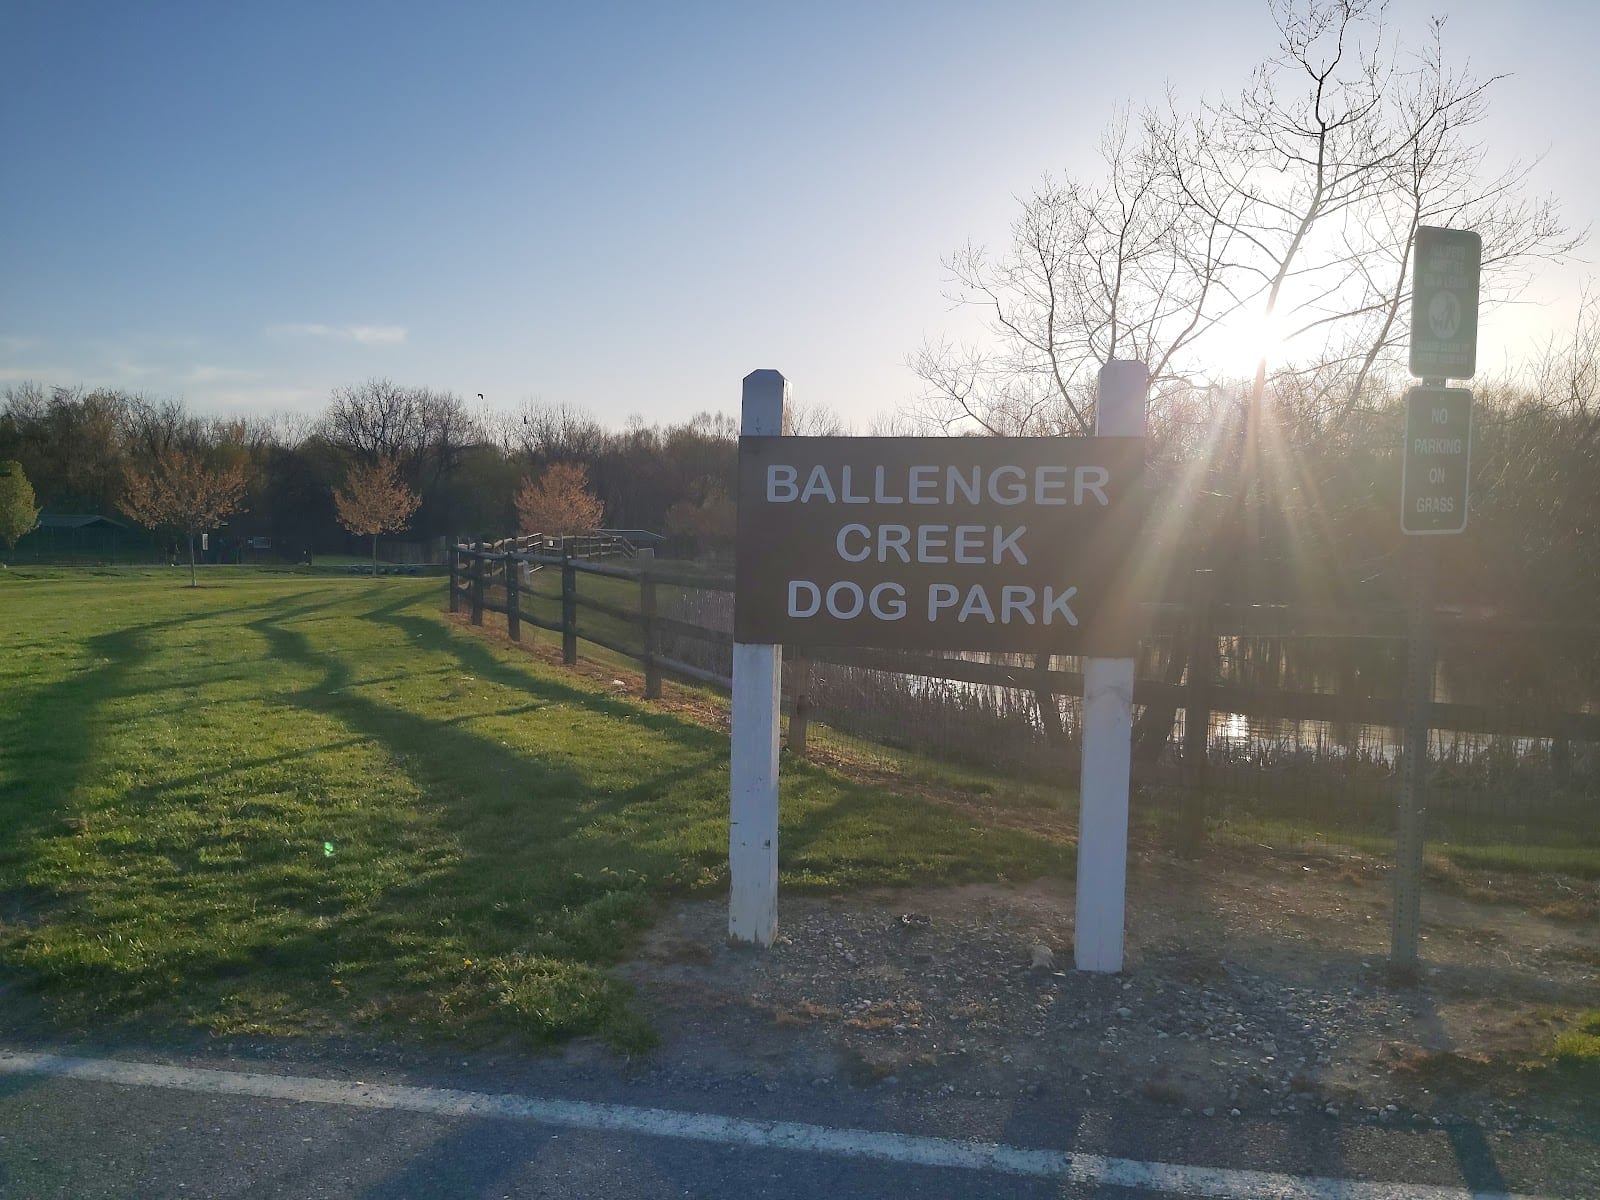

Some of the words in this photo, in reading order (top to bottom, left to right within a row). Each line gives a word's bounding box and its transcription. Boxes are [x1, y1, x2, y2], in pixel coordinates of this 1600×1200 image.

[1431, 407, 1448, 424] NO
[1415, 438, 1462, 455] PARKING
[1429, 467, 1446, 484] ON
[766, 464, 1111, 505] BALLENGER
[1416, 496, 1455, 513] GRASS
[836, 523, 1028, 565] CREEK
[787, 580, 907, 621] DOG
[928, 583, 1079, 626] PARK
